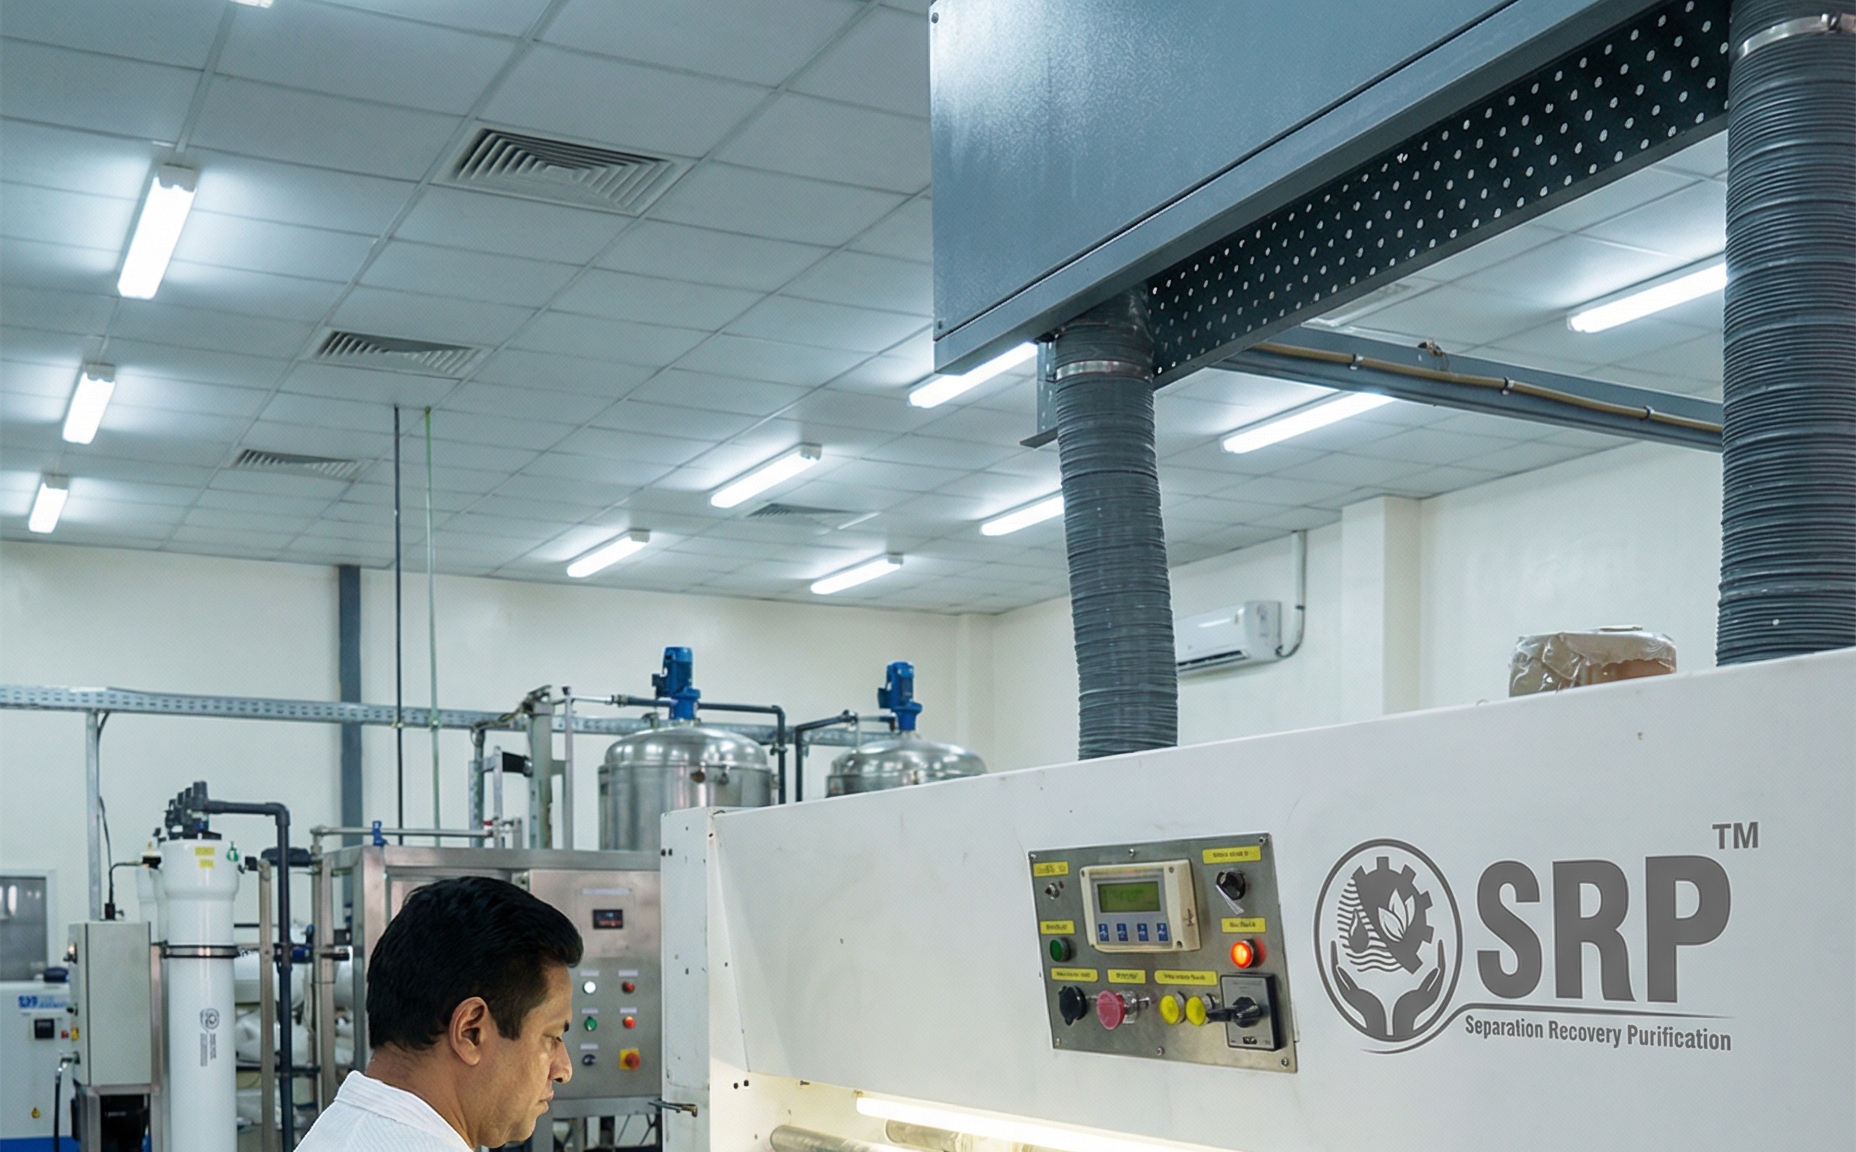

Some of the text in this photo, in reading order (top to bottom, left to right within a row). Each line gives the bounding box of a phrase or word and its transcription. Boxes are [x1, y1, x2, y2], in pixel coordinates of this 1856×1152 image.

[1477, 822, 1758, 1003] SRP TM
[1465, 1014, 1732, 1051] Separation Recovery Purification
